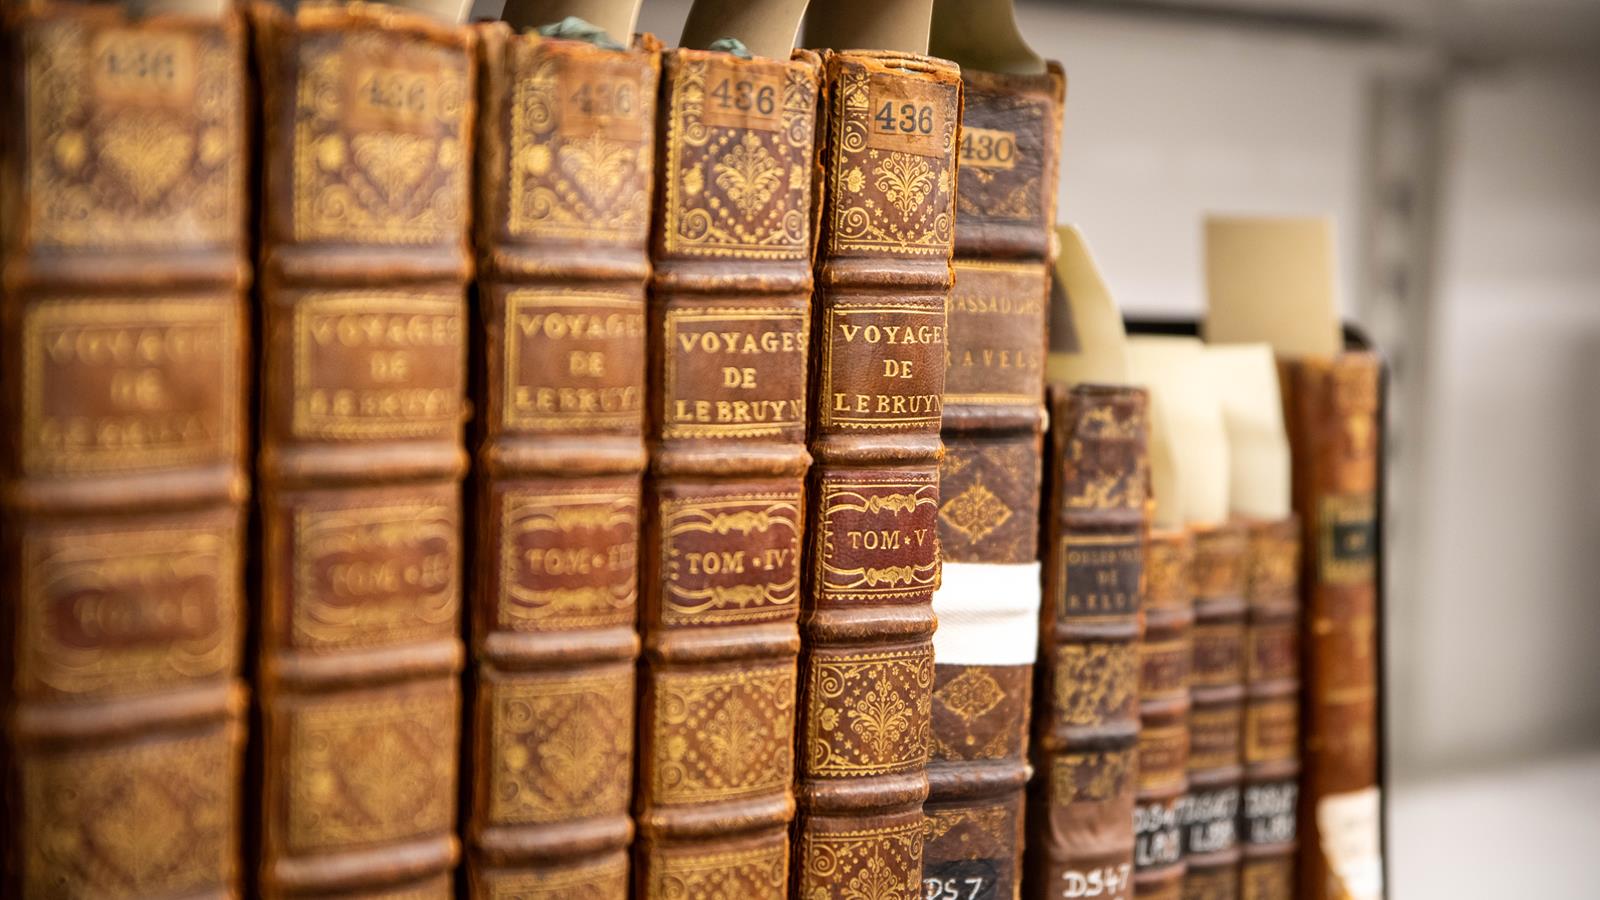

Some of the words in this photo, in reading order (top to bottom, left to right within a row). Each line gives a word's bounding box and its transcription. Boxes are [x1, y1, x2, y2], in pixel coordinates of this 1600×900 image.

[711, 78, 775, 115] 436
[874, 100, 934, 136] 436
[960, 132, 1013, 162] 430
[680, 330, 807, 354] VOYAGES
[569, 350, 605, 377] DE
[882, 359, 913, 379] DE
[722, 366, 758, 390] DE
[847, 530, 901, 551] TOM
[913, 528, 928, 547] V
[685, 550, 746, 575] TOM
[763, 548, 790, 571] IV
